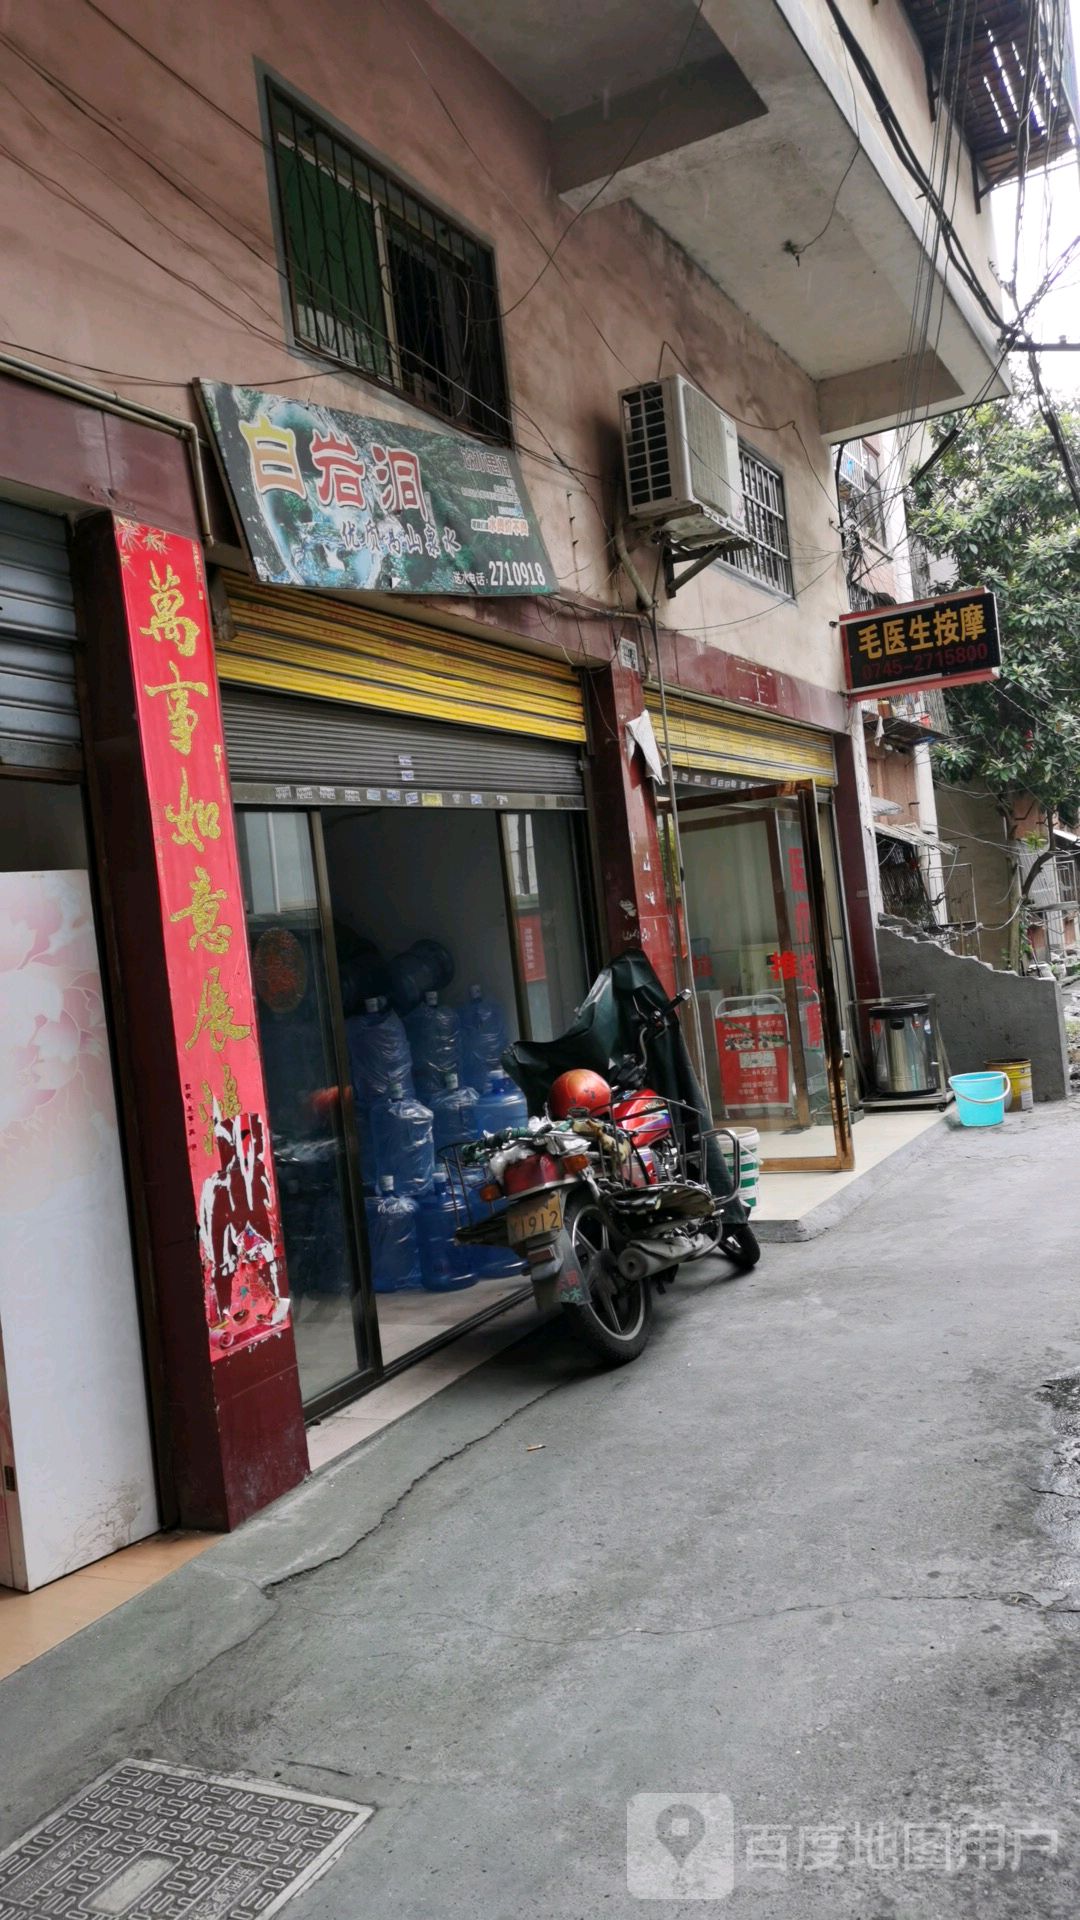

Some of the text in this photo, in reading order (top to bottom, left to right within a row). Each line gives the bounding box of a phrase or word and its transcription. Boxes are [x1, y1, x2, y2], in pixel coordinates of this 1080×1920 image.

[238, 414, 429, 521] 白岩洞
[488, 561, 546, 586] 2710918
[857, 603, 987, 660] 毛医生按摩
[861, 642, 988, 681] 0745-2715800
